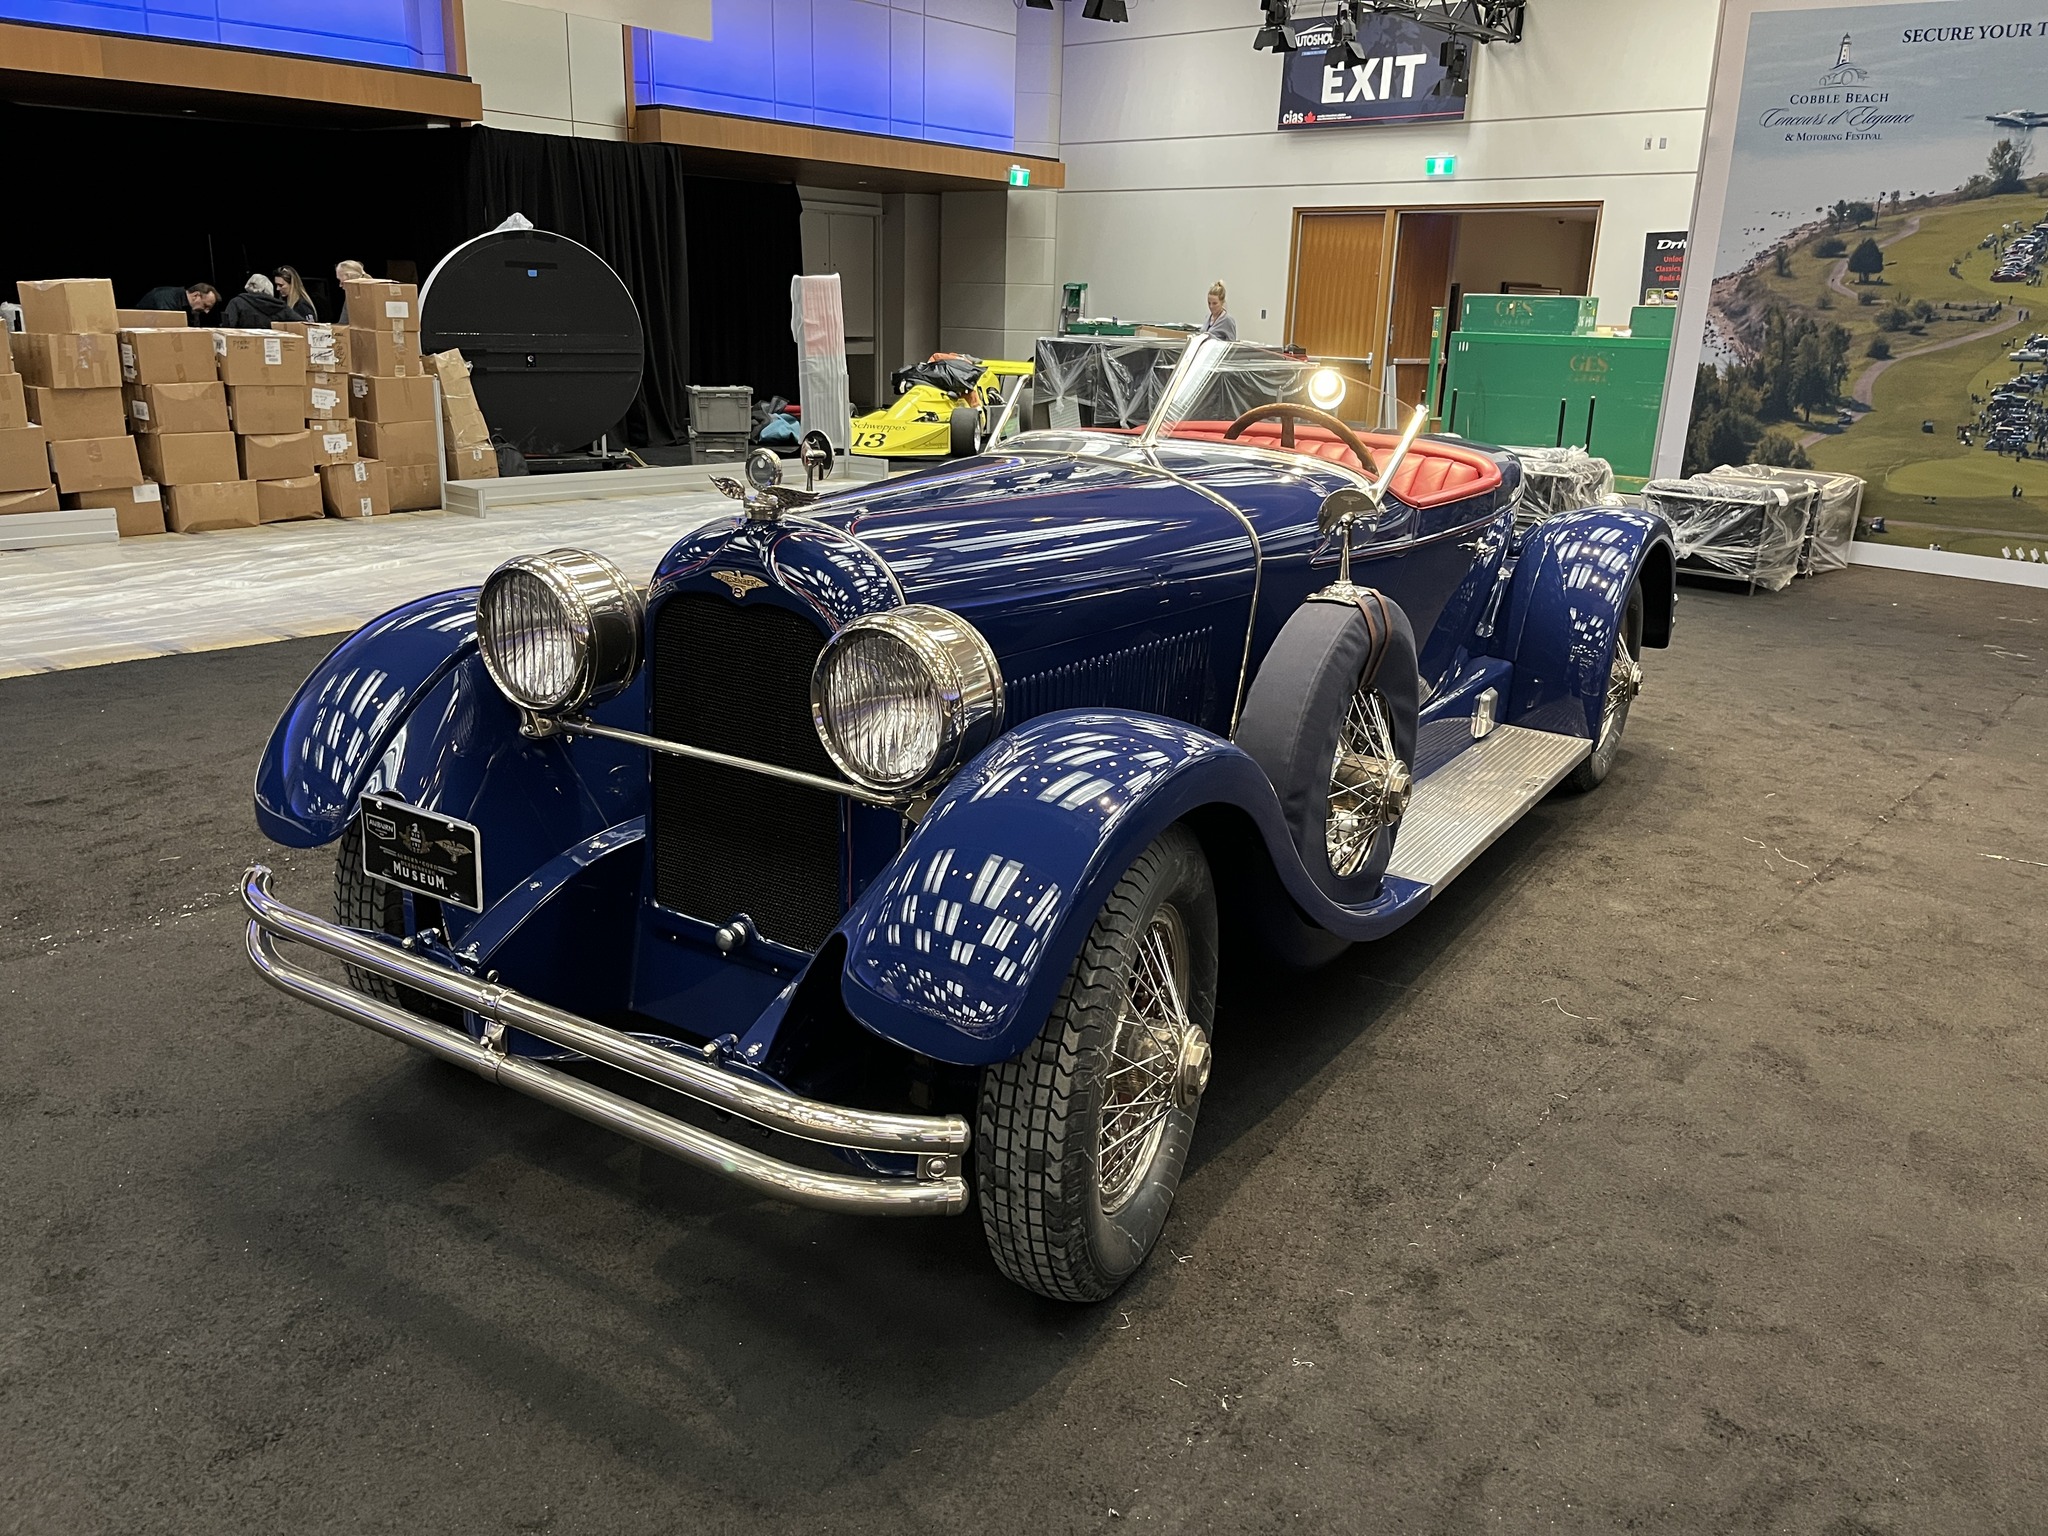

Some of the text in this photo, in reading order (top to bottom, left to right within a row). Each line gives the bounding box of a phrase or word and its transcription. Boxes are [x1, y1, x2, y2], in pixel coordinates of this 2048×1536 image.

[1902, 26, 1974, 43] SECURE
[1979, 23, 2032, 40] YOUR
[1320, 53, 1427, 104] EXIT
[1789, 92, 1890, 105] COBBLE BEACH
[1759, 107, 1828, 128] Concours
[1784, 131, 1883, 141] & MOTORING FESTIVAL
[851, 420, 907, 433] Schweppes
[852, 432, 887, 448] 13
